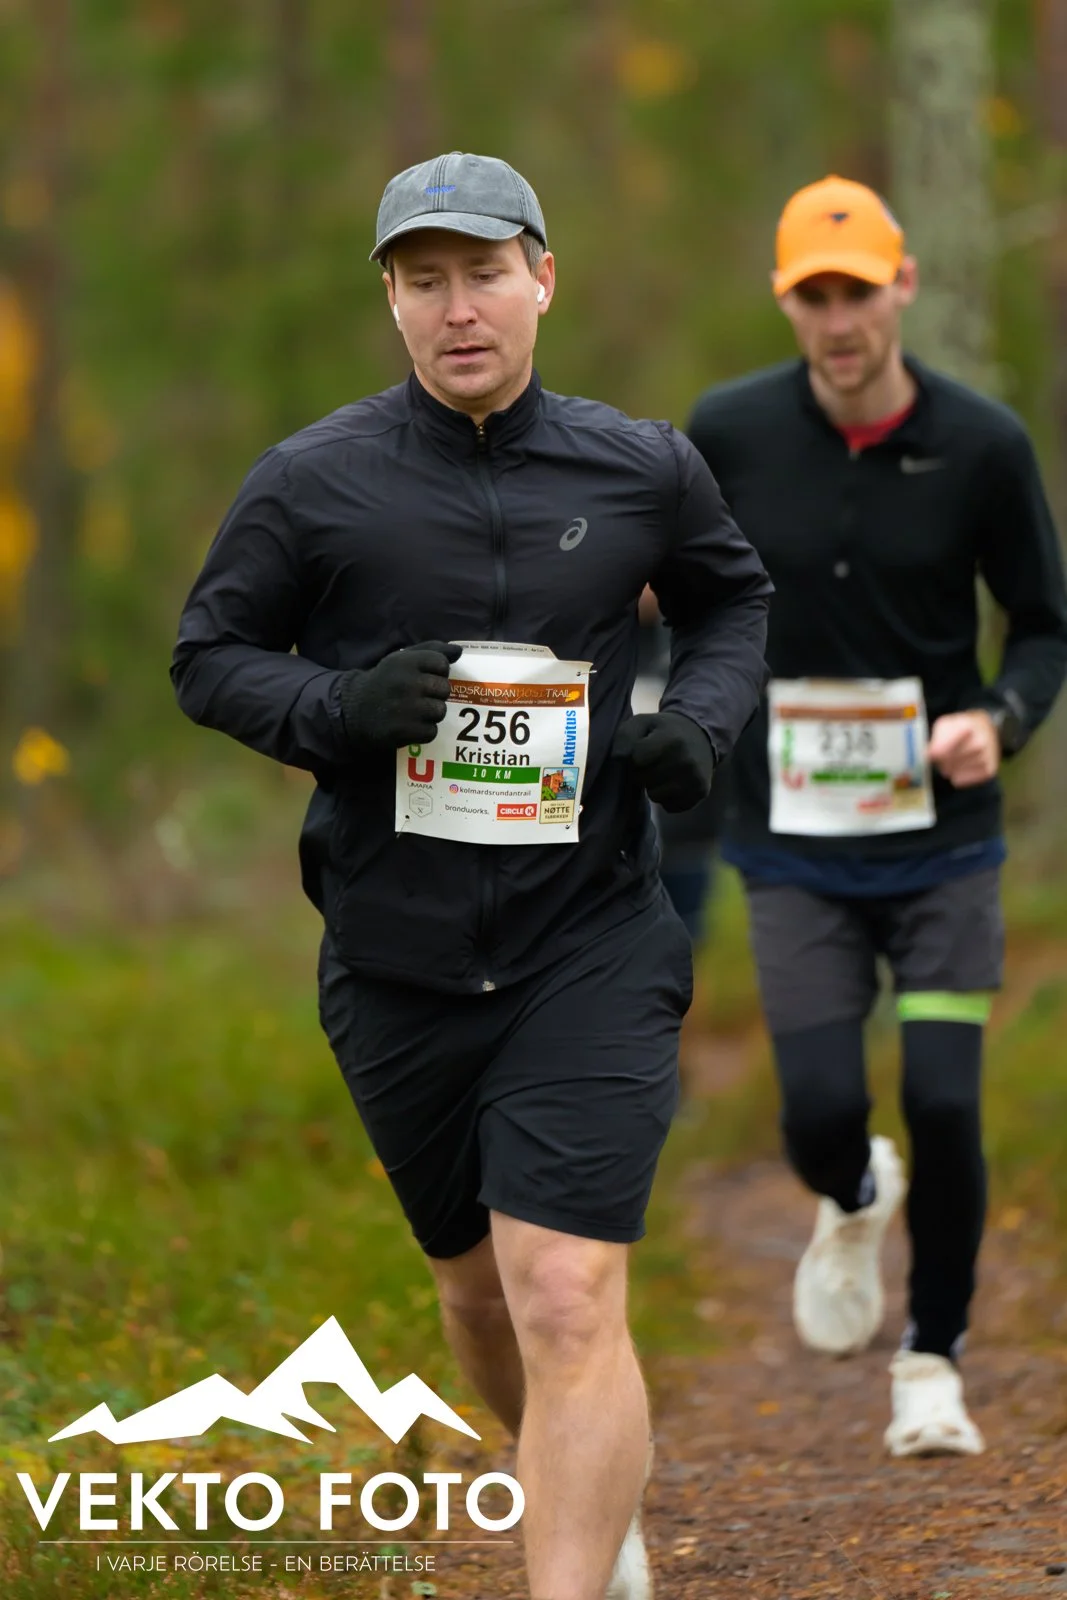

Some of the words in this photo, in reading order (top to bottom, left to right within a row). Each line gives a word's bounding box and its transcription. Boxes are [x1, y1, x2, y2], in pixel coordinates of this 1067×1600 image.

[546, 689, 571, 698] TRAIL
[456, 708, 531, 745] 256
[563, 710, 576, 765] Aktivitus
[455, 746, 530, 766] Kristian
[473, 768, 486, 778] 10
[495, 769, 512, 779] KM
[460, 786, 531, 797] kolmardsrundantrail
[499, 807, 524, 815] CIRCLE
[544, 806, 570, 815] NØTTE
